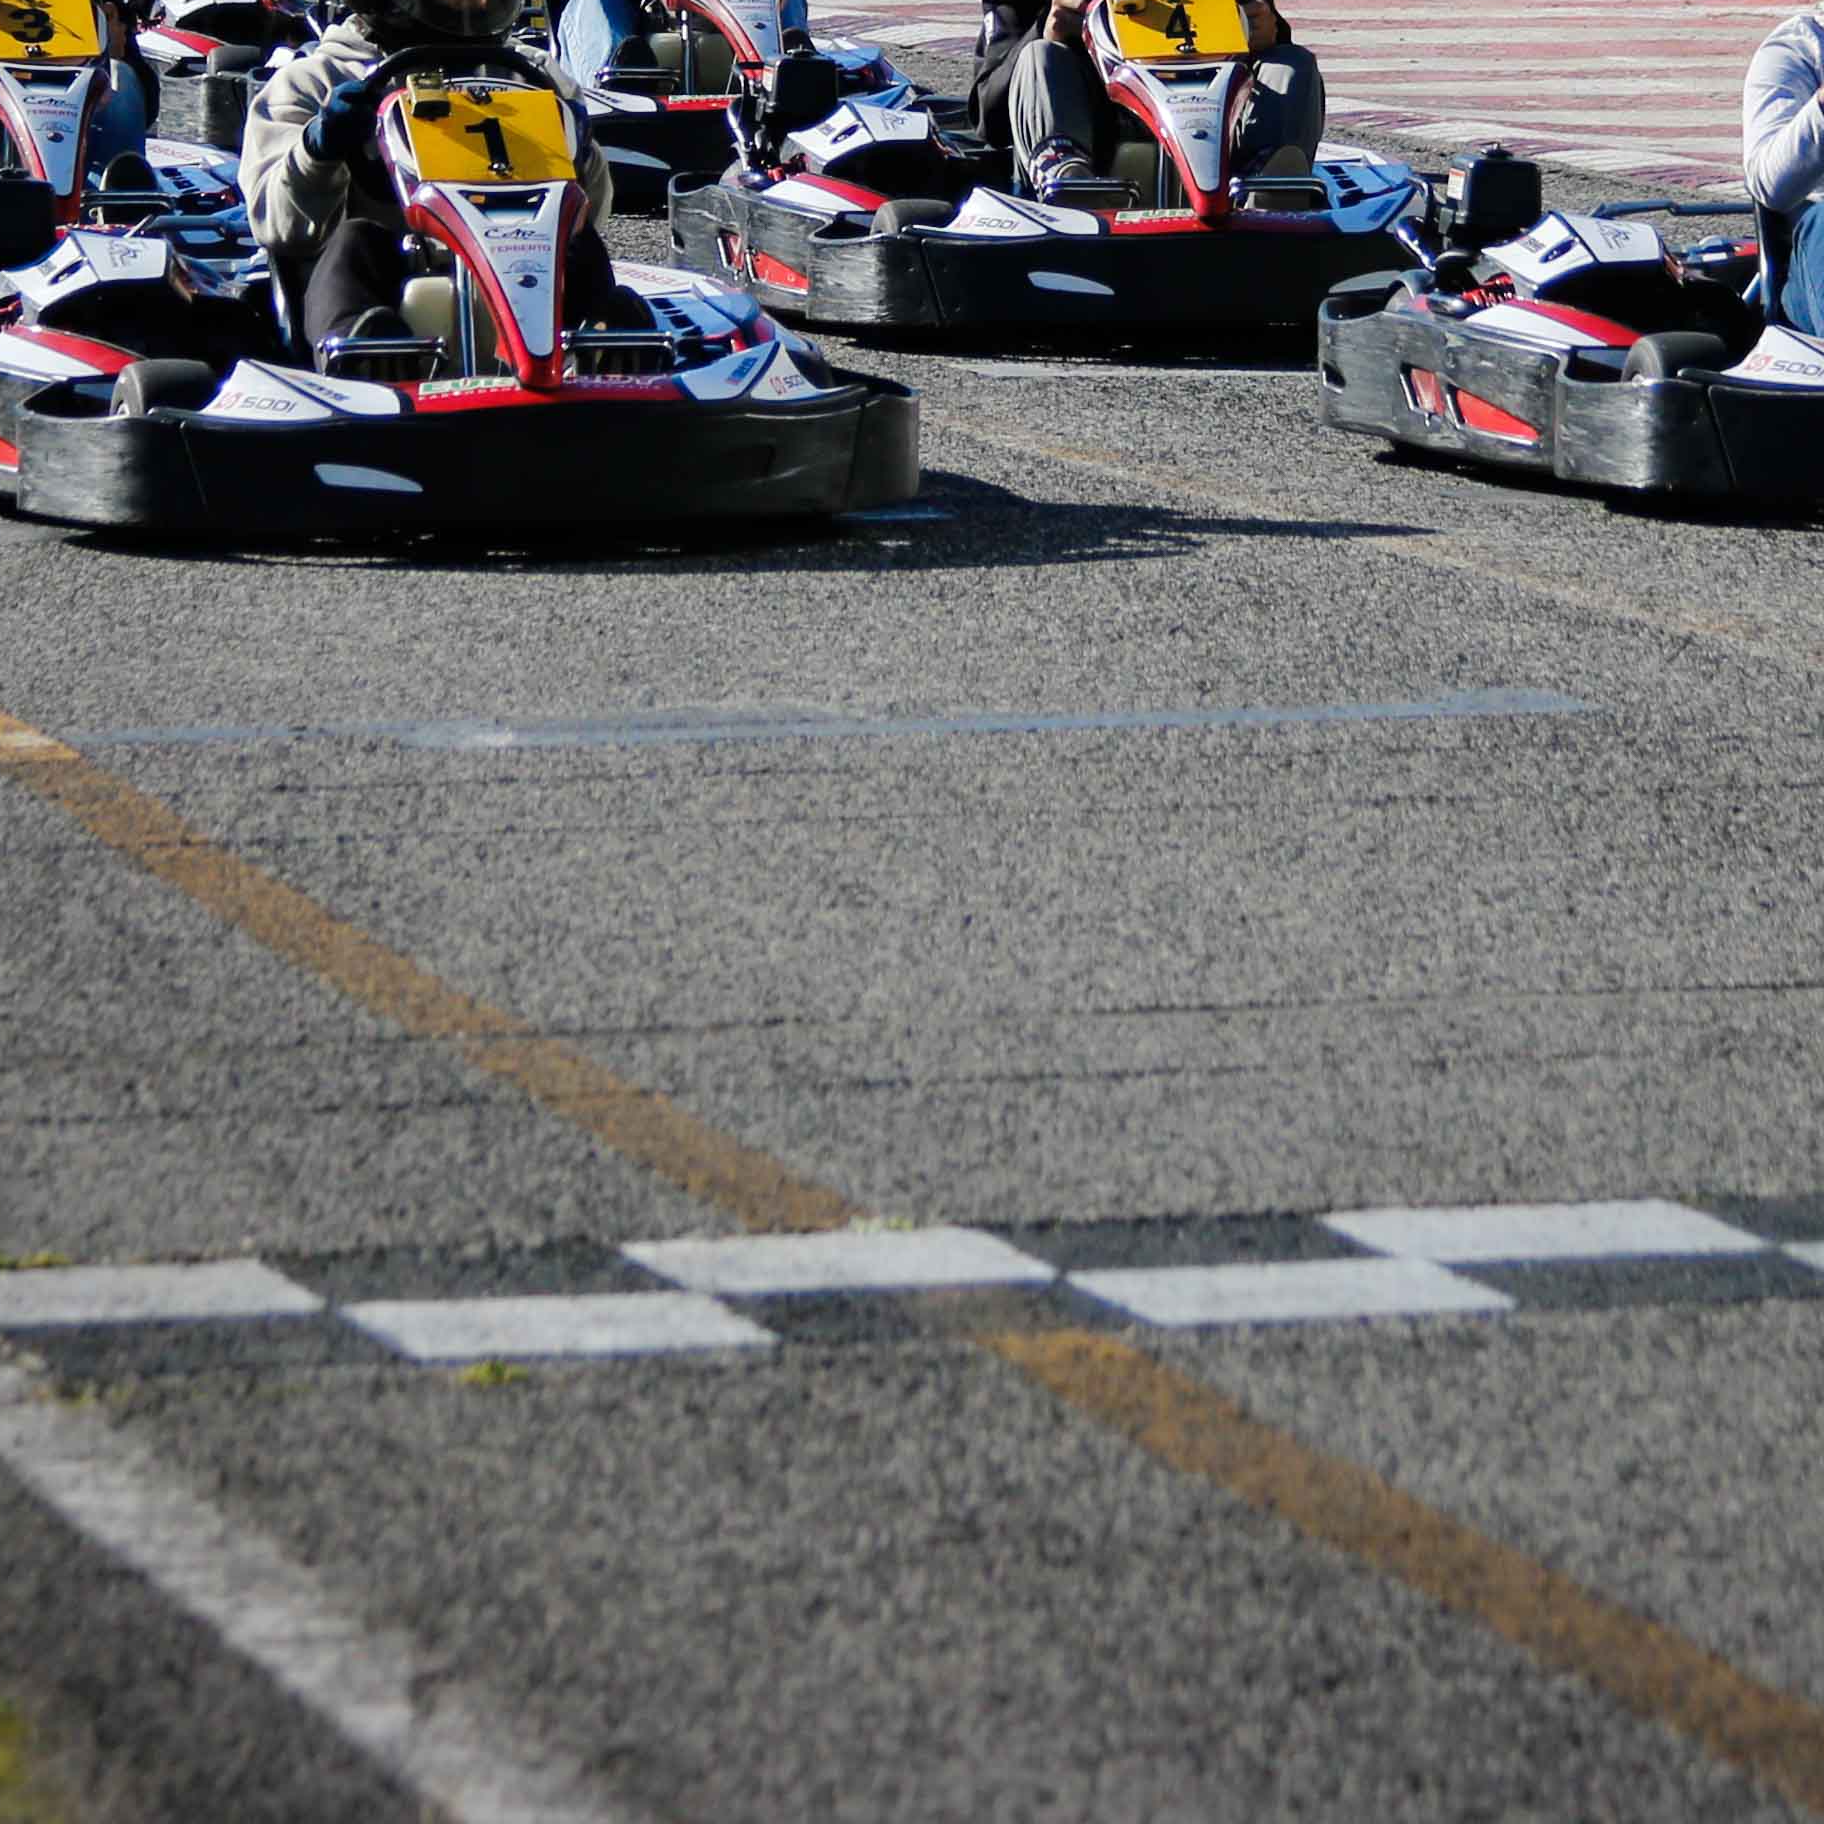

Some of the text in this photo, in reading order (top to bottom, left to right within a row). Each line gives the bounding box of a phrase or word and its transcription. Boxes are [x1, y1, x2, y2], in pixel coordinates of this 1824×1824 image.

[10, 8, 54, 43] 3
[1165, 2, 1198, 50] 4
[464, 117, 512, 176] 1
[973, 215, 1020, 232] SODI
[241, 394, 296, 412] SODI
